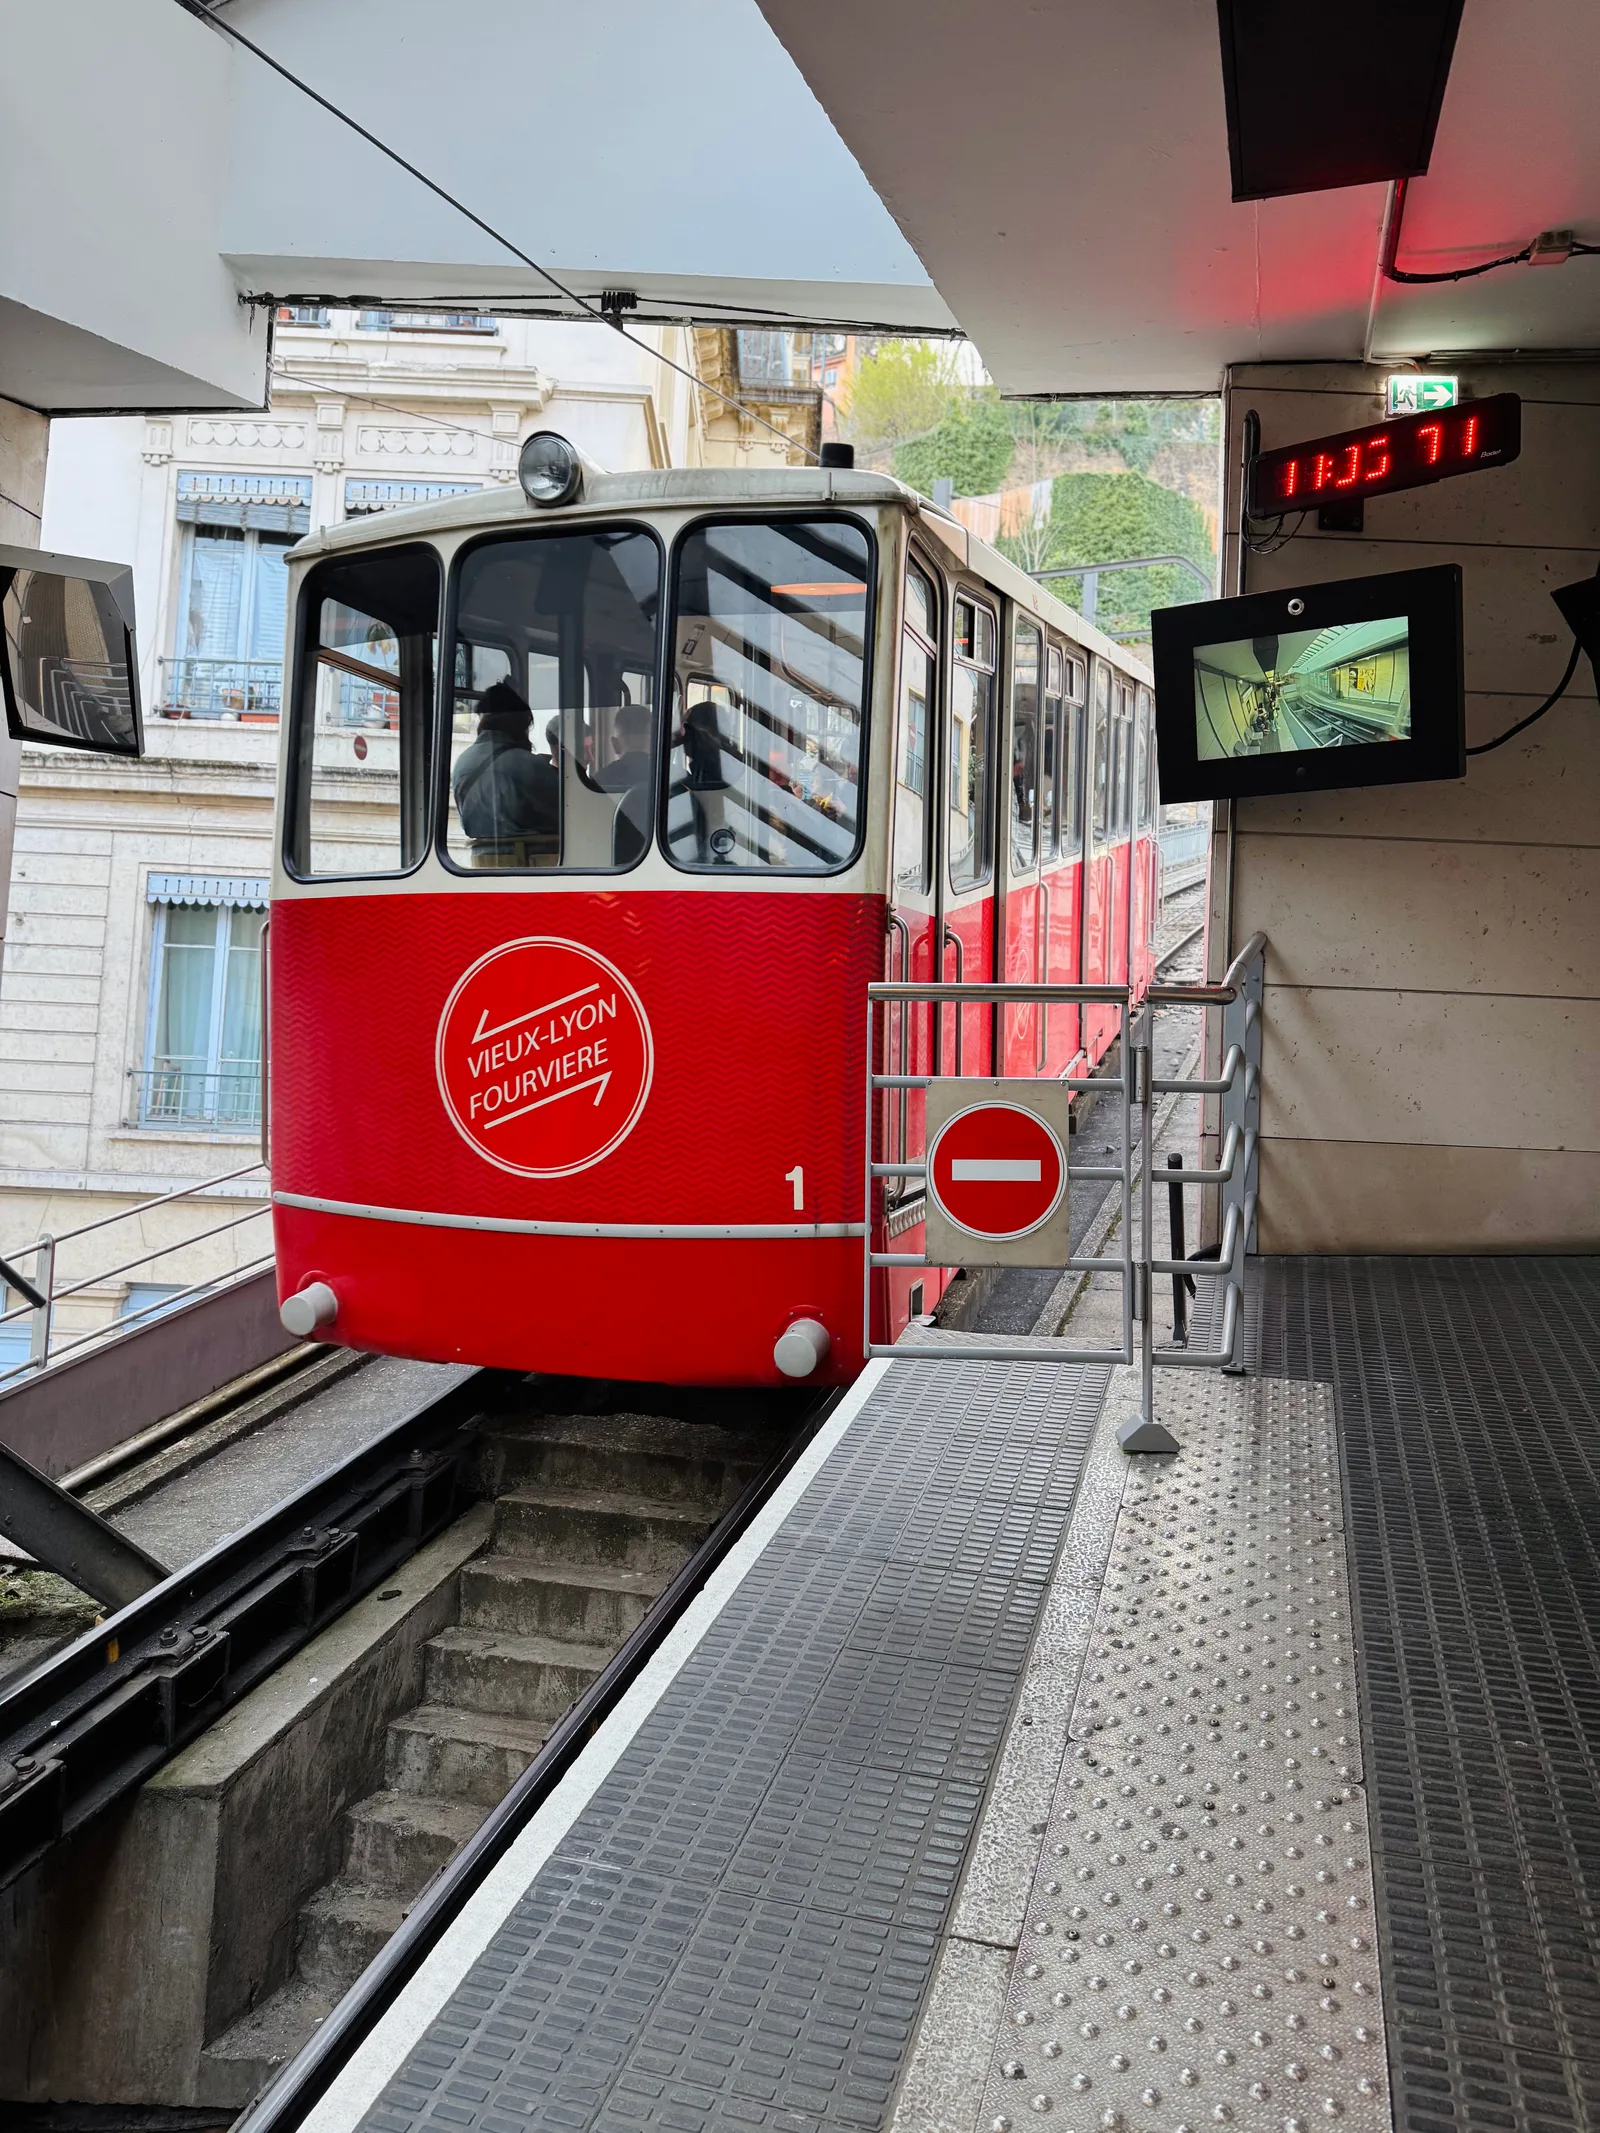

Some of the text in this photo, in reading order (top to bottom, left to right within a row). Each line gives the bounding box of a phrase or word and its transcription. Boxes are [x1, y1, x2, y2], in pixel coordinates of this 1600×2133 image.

[467, 993, 617, 1079] VIEUX-LYON
[469, 1037, 609, 1120] FOURVIERE
[785, 1165, 804, 1211] 1
